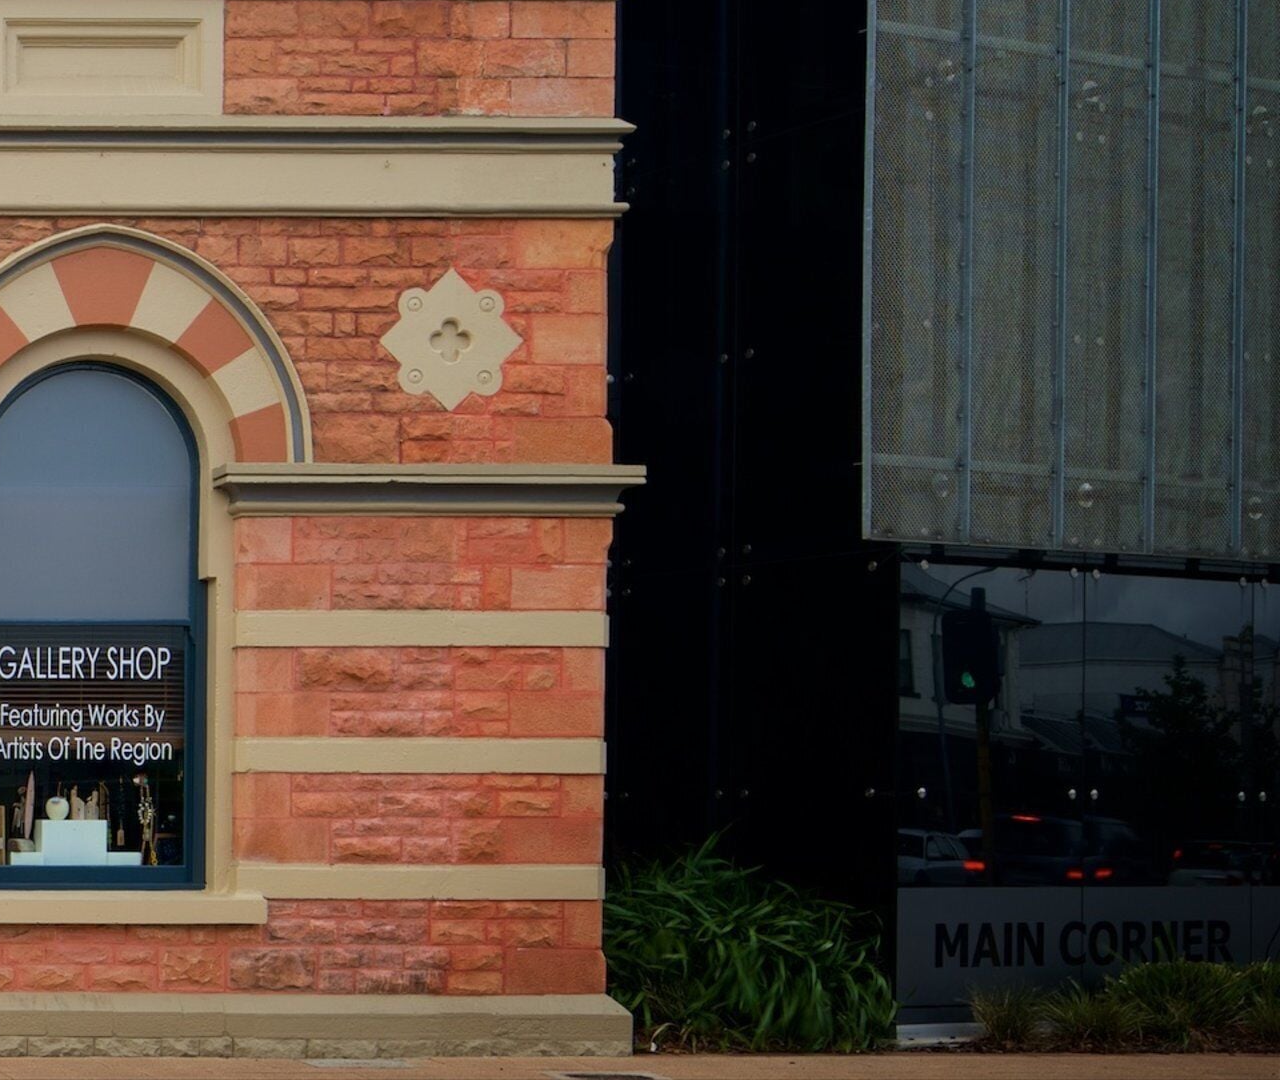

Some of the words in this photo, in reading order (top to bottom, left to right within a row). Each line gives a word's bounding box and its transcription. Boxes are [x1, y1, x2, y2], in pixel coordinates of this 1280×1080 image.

[106, 645, 171, 680] SHOP
[0, 703, 83, 732] Featuring
[87, 704, 140, 728] Works
[145, 705, 165, 732] By
[48, 736, 71, 760] Of
[75, 737, 105, 760] The
[110, 737, 173, 767] Region
[933, 921, 1045, 969] MAIN
[1059, 919, 1235, 970] CORNER
